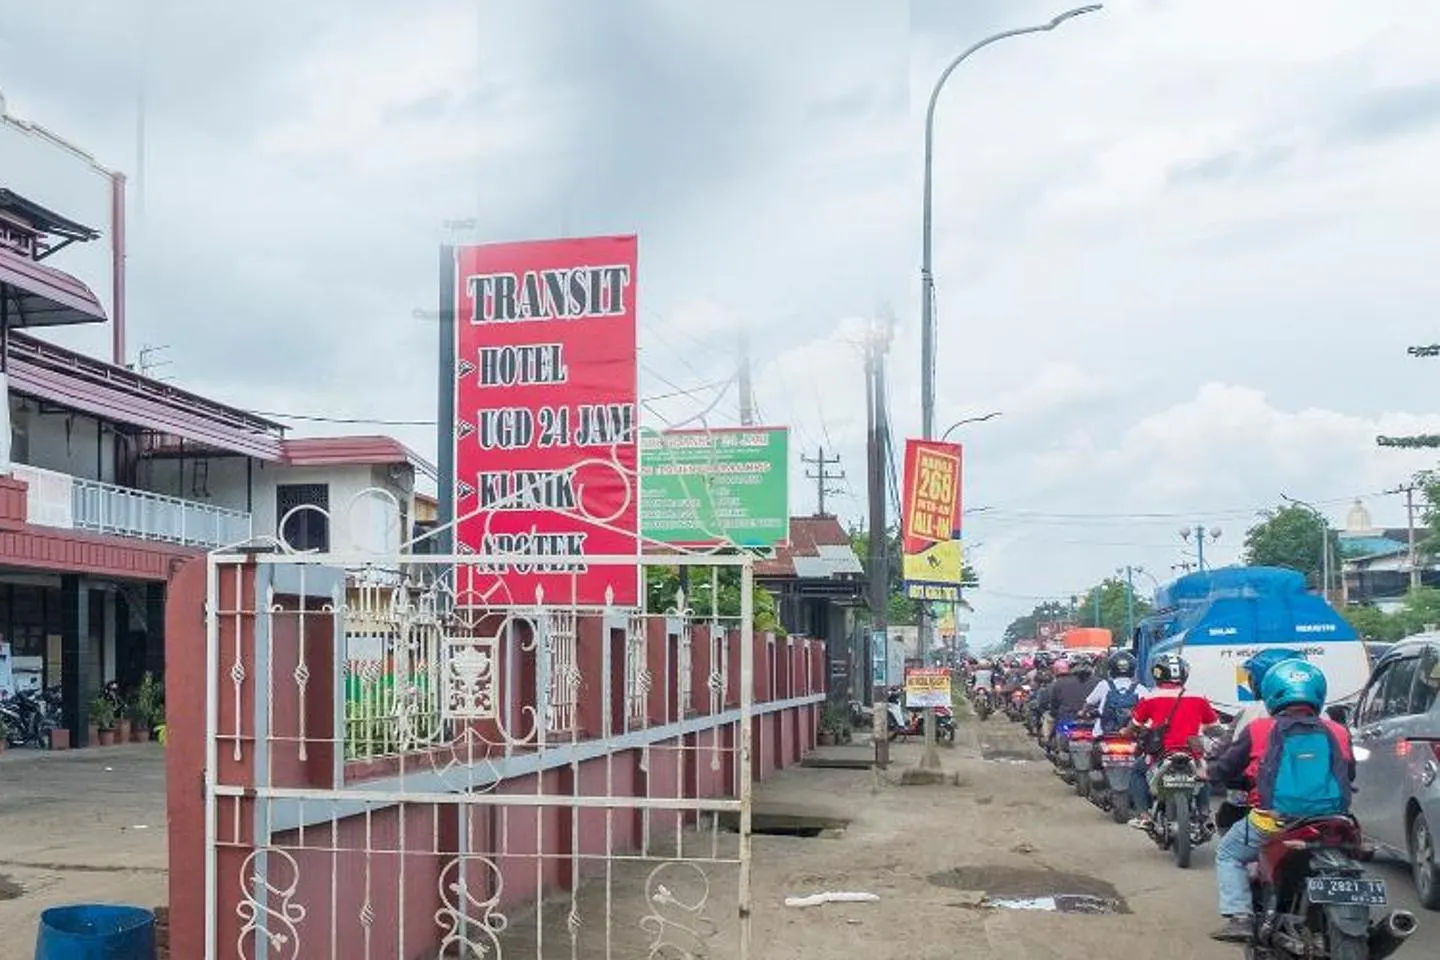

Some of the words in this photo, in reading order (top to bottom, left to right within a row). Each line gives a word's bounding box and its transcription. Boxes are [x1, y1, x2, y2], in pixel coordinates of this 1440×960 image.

[467, 263, 631, 326] TRANSIT
[478, 342, 567, 388] HOTEL
[478, 407, 533, 452] UGD
[538, 406, 570, 448] 24
[575, 402, 634, 447] JAM
[477, 470, 577, 511] KLINIK
[477, 531, 588, 574] APOTEK
